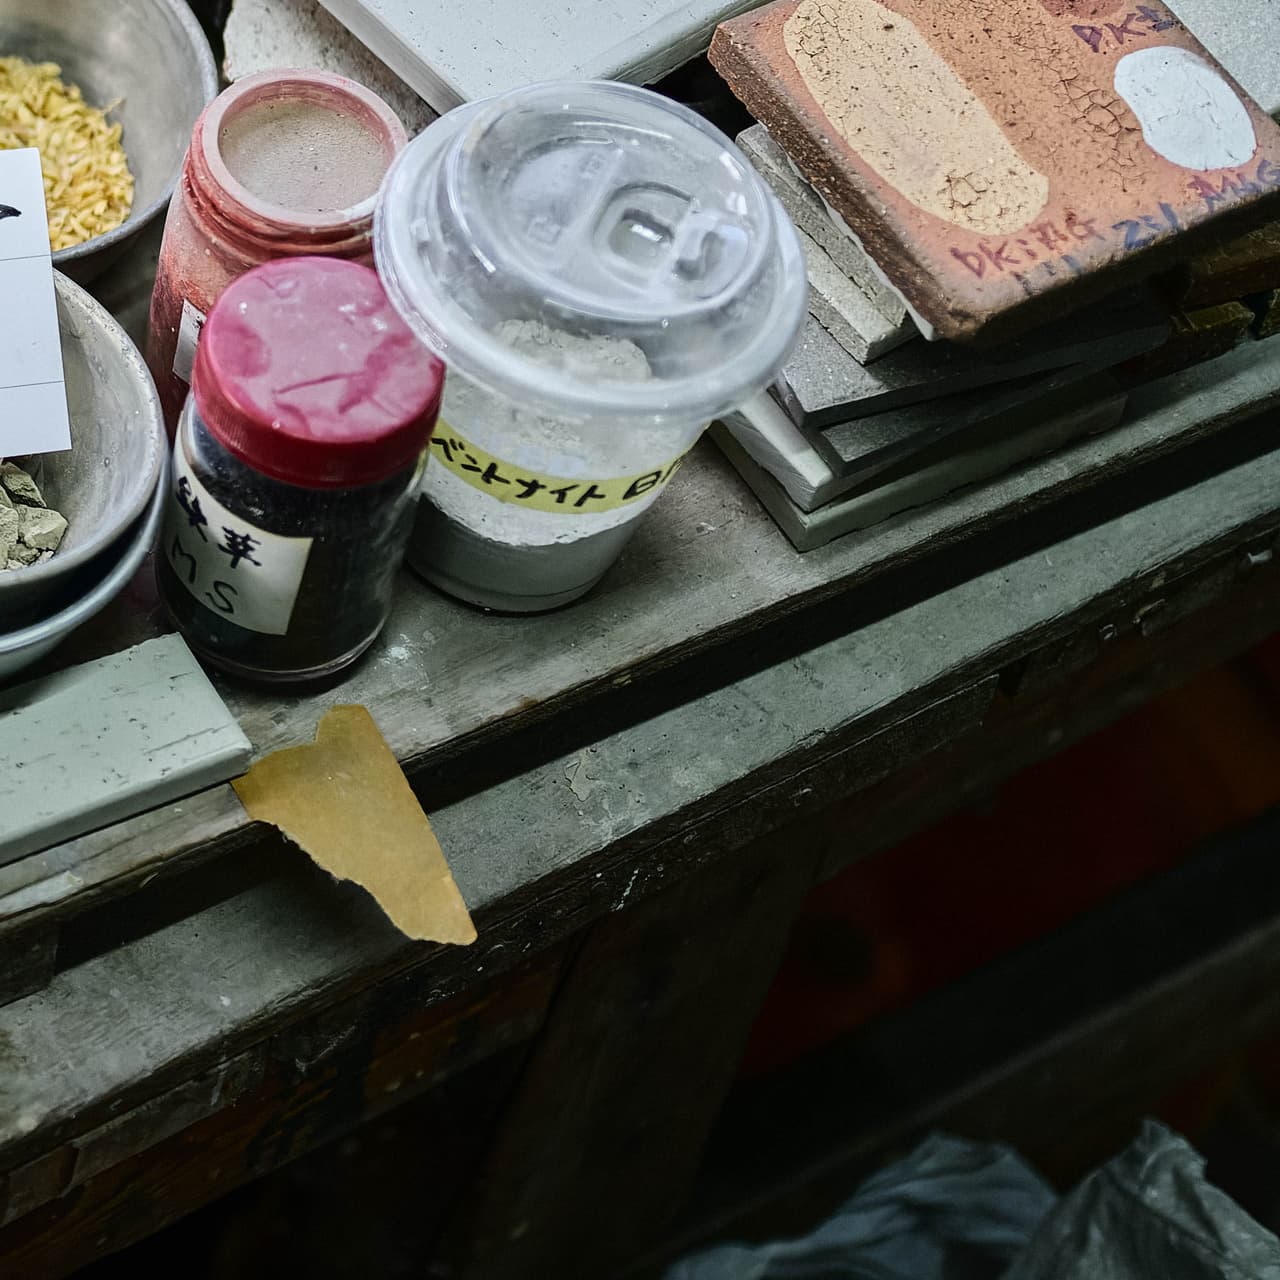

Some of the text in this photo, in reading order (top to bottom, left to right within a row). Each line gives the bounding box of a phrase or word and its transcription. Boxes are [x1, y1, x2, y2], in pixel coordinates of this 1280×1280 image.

[431, 436, 607, 508] ベントナイト
